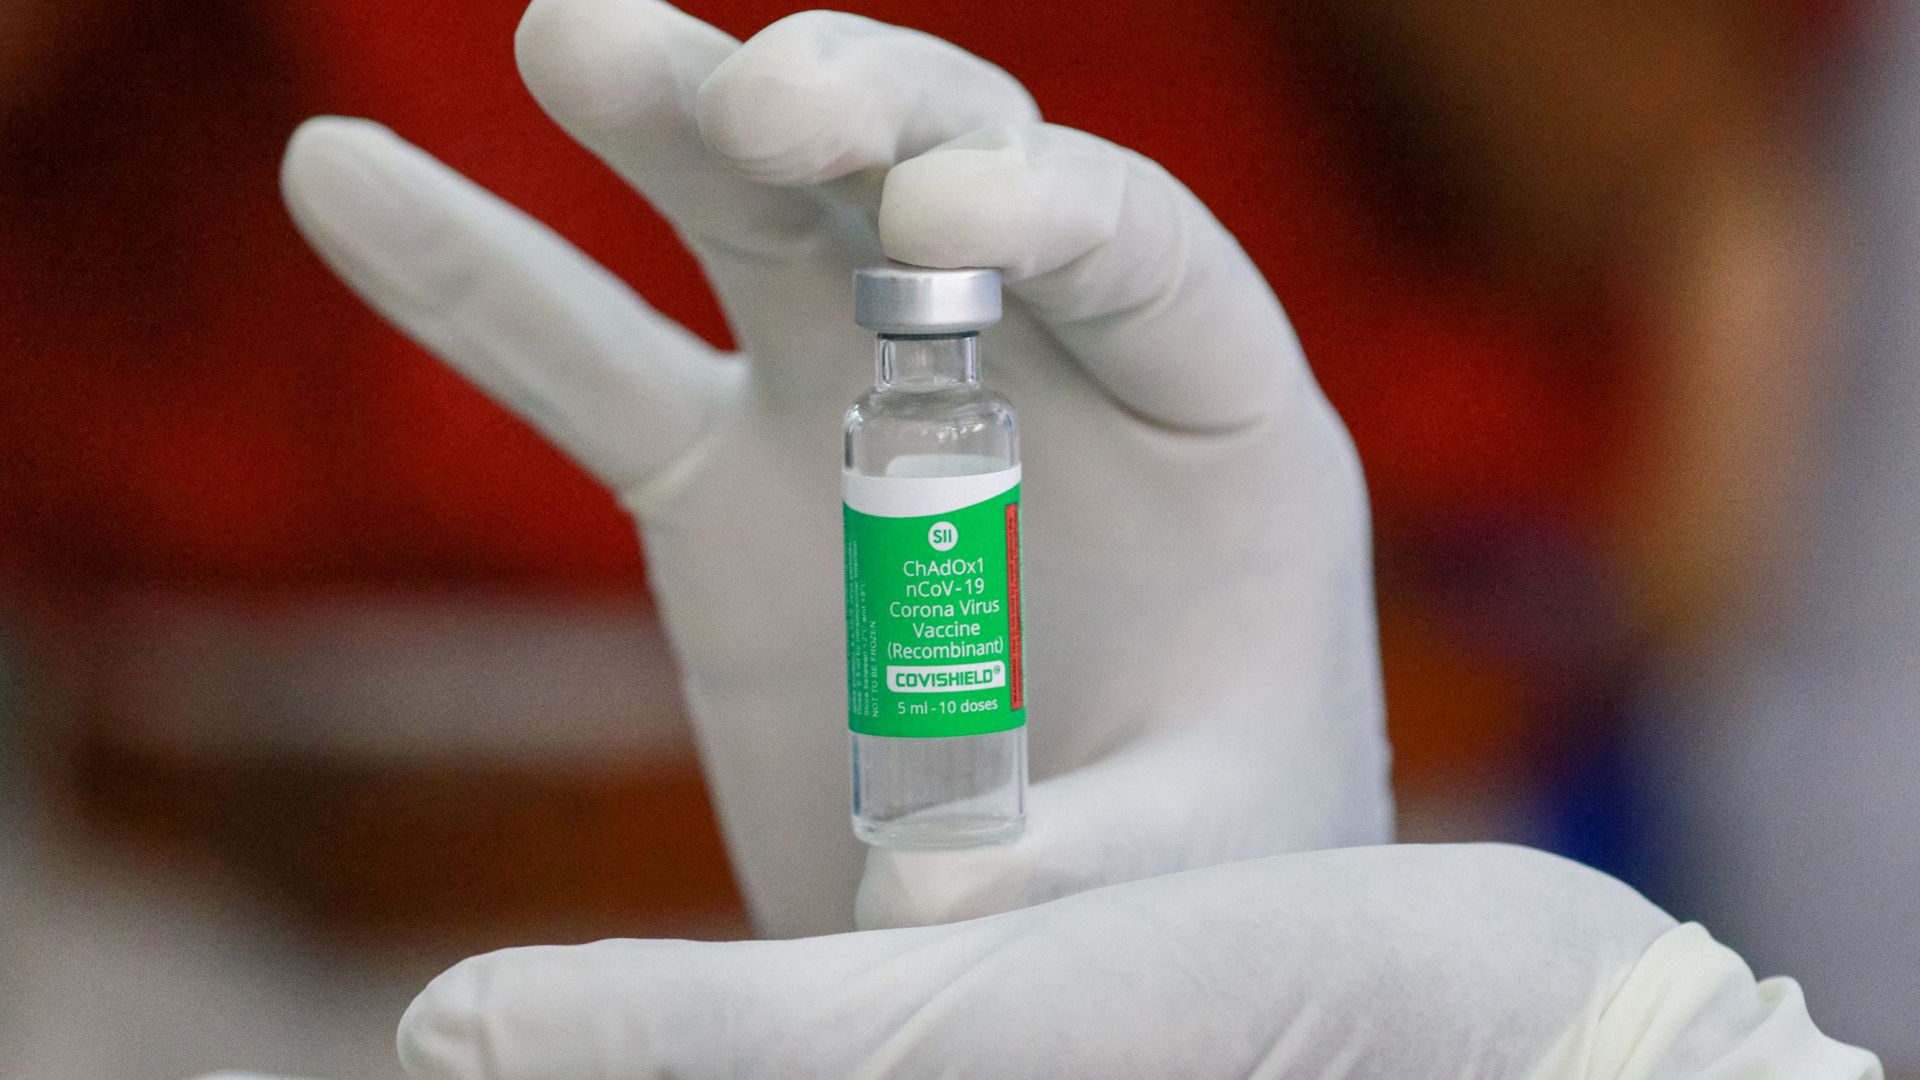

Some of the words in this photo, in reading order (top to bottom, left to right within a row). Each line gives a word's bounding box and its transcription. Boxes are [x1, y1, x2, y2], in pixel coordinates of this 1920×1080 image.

[932, 528, 953, 544] SII
[903, 557, 984, 577] ChAdOx1
[889, 601, 955, 618] Corona
[959, 599, 1001, 616] Virus
[912, 620, 981, 639] Vaccine
[869, 621, 877, 662] FROZEN
[887, 635, 1004, 660] (Recombinant)
[870, 665, 878, 678] BE
[871, 680, 879, 693] TO
[871, 697, 879, 718] NOT
[897, 701, 906, 715] 5
[910, 701, 929, 715] ml
[939, 701, 957, 714] 10
[960, 698, 999, 712] doses
